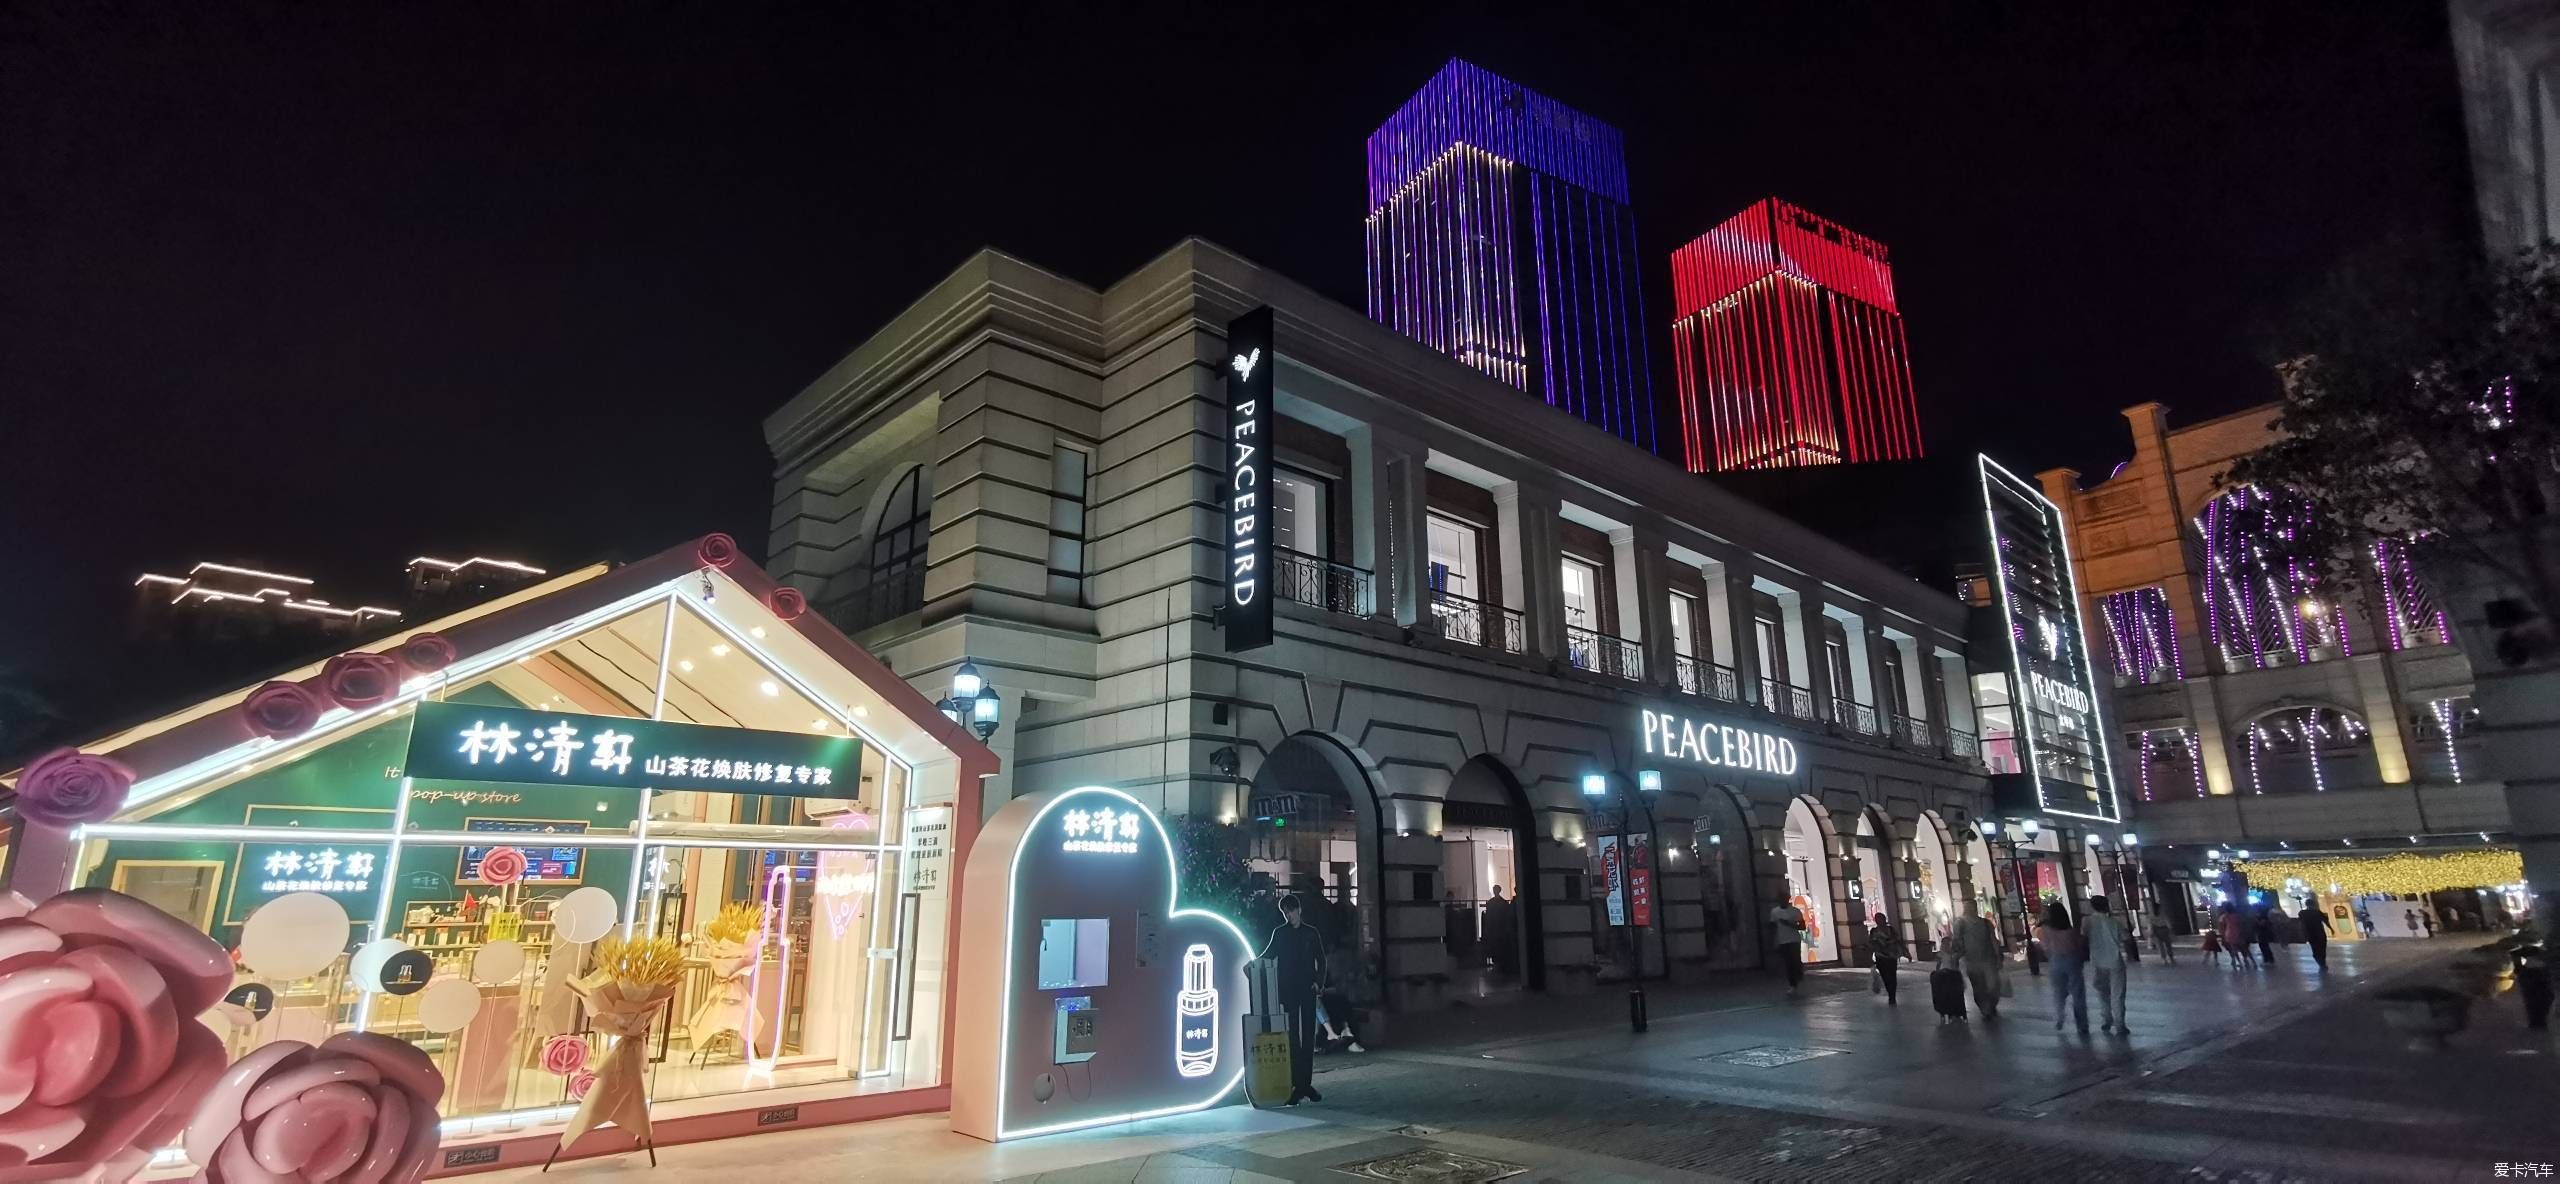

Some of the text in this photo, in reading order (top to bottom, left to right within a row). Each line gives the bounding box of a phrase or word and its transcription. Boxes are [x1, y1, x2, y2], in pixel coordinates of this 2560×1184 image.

[1234, 399, 1256, 606] PEACEBIRD
[2030, 671, 2089, 714] PEACEBIRD
[1642, 708, 1798, 775] PEACEBIRD
[645, 755, 833, 786] 山茶花焕肤修复专家
